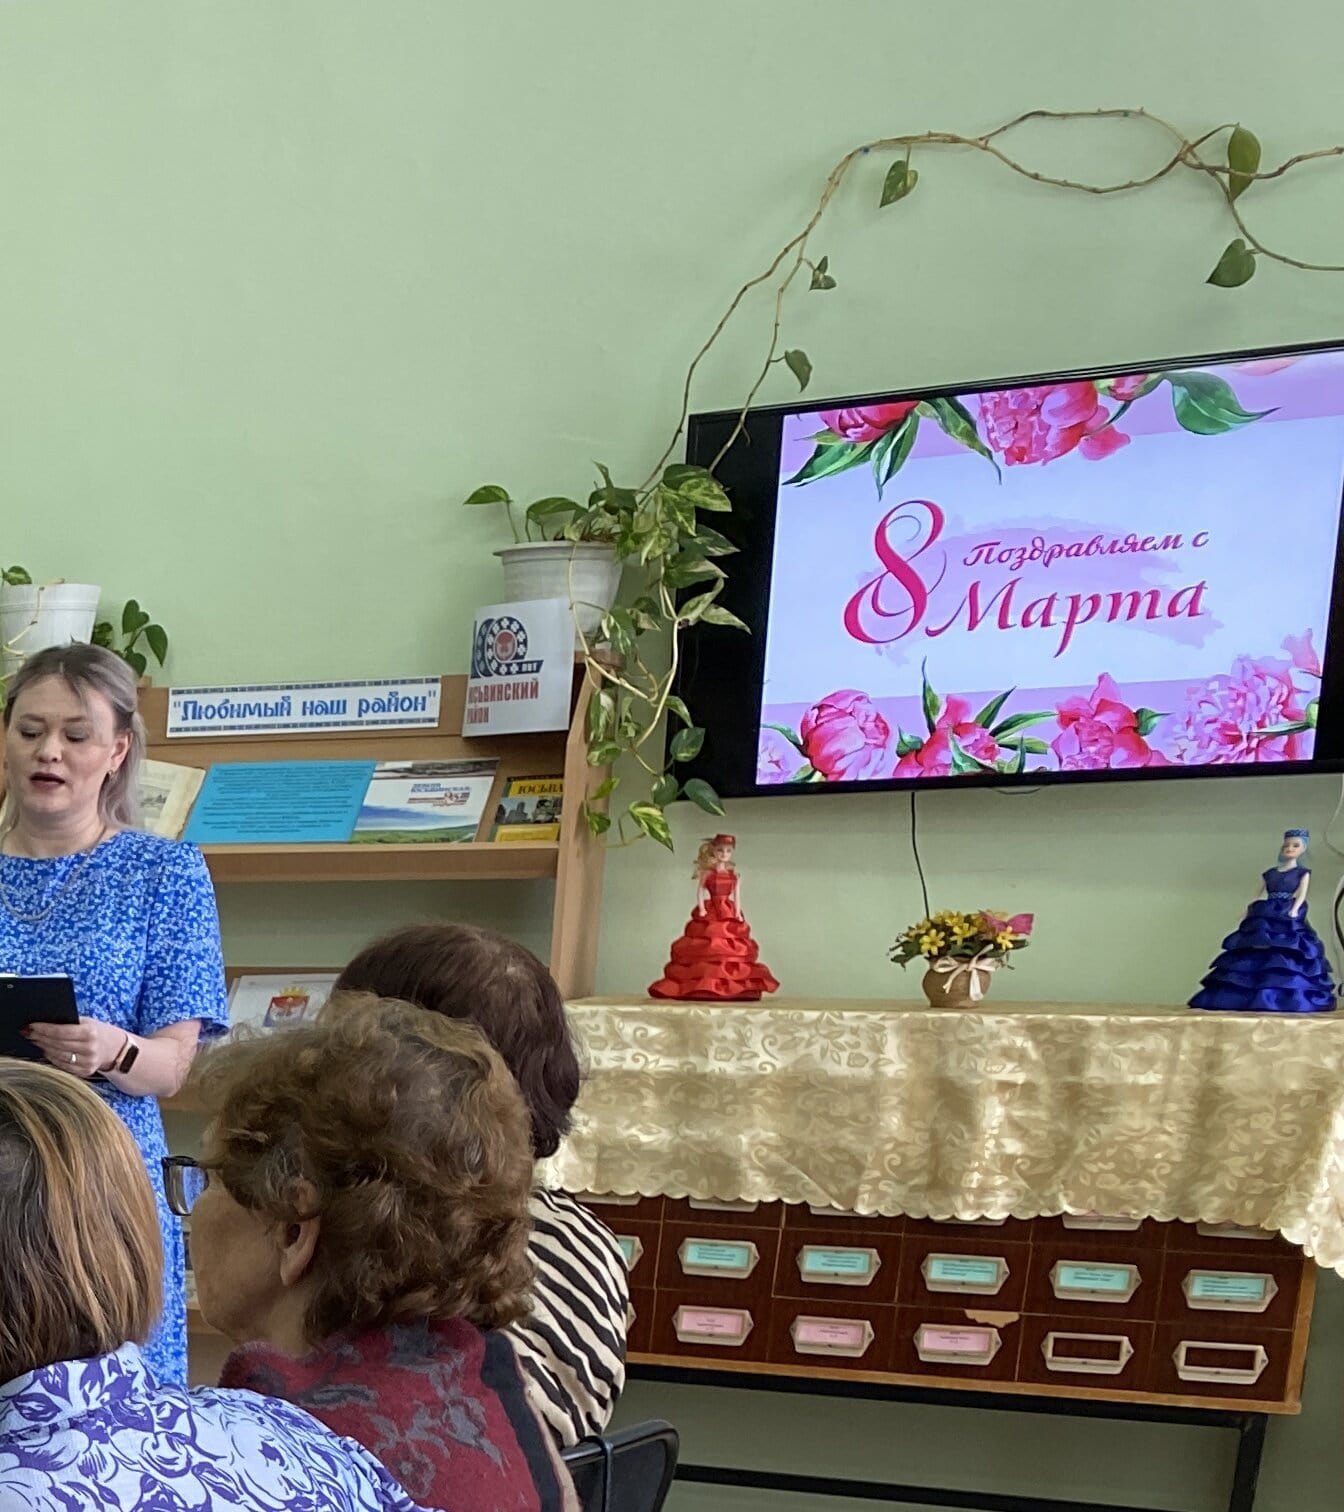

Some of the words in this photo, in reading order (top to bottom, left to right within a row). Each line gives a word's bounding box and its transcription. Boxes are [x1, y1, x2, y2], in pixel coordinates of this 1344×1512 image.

[963, 532, 1184, 571] Поздравляем
[1192, 531, 1209, 548] с
[843, 499, 947, 644] 8
[924, 577, 1210, 659] Марта
[301, 698, 347, 717] наш
